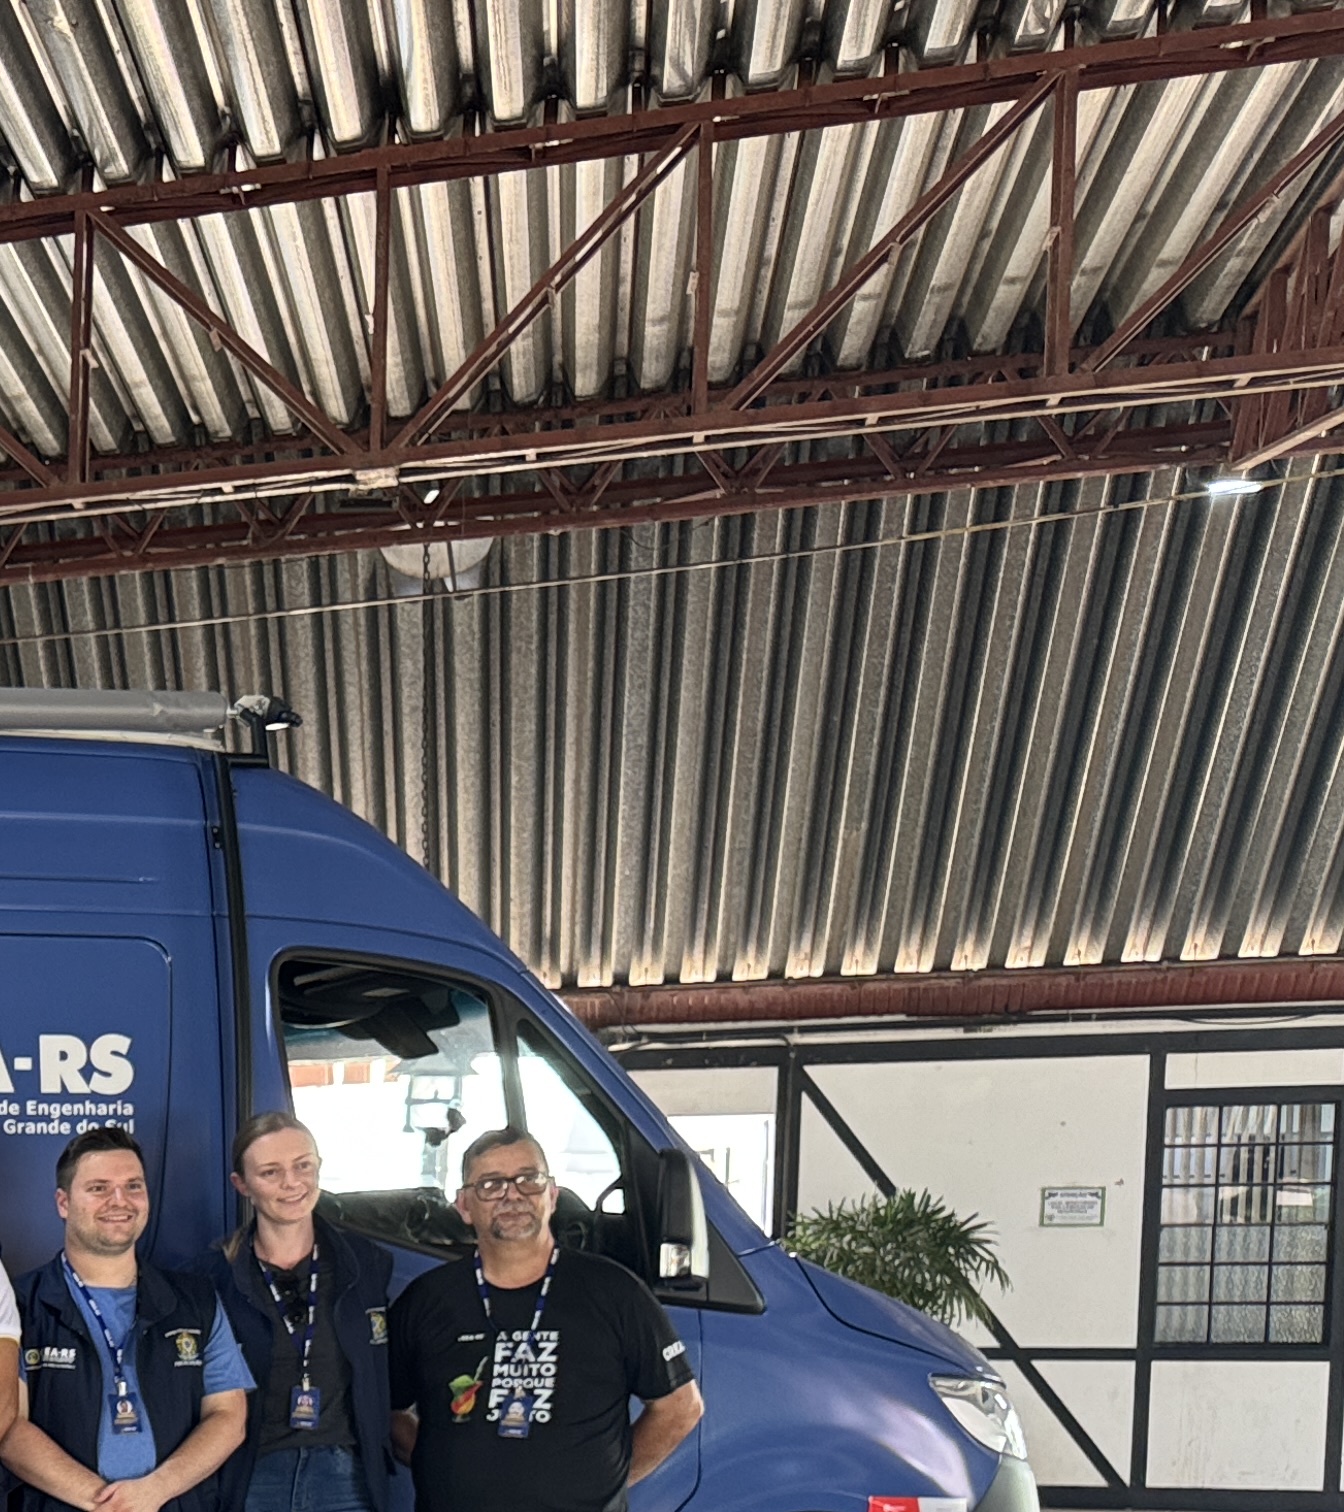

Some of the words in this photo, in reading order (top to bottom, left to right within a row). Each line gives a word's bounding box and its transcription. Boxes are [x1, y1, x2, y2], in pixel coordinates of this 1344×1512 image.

[25, 1099, 135, 1119] Engenharia
[2, 1118, 72, 1136] Grande
[494, 1341, 559, 1363] FAZ
[492, 1362, 557, 1378] MUITO
[491, 1377, 556, 1390] PORQUE
[487, 1388, 554, 1411] FZ
